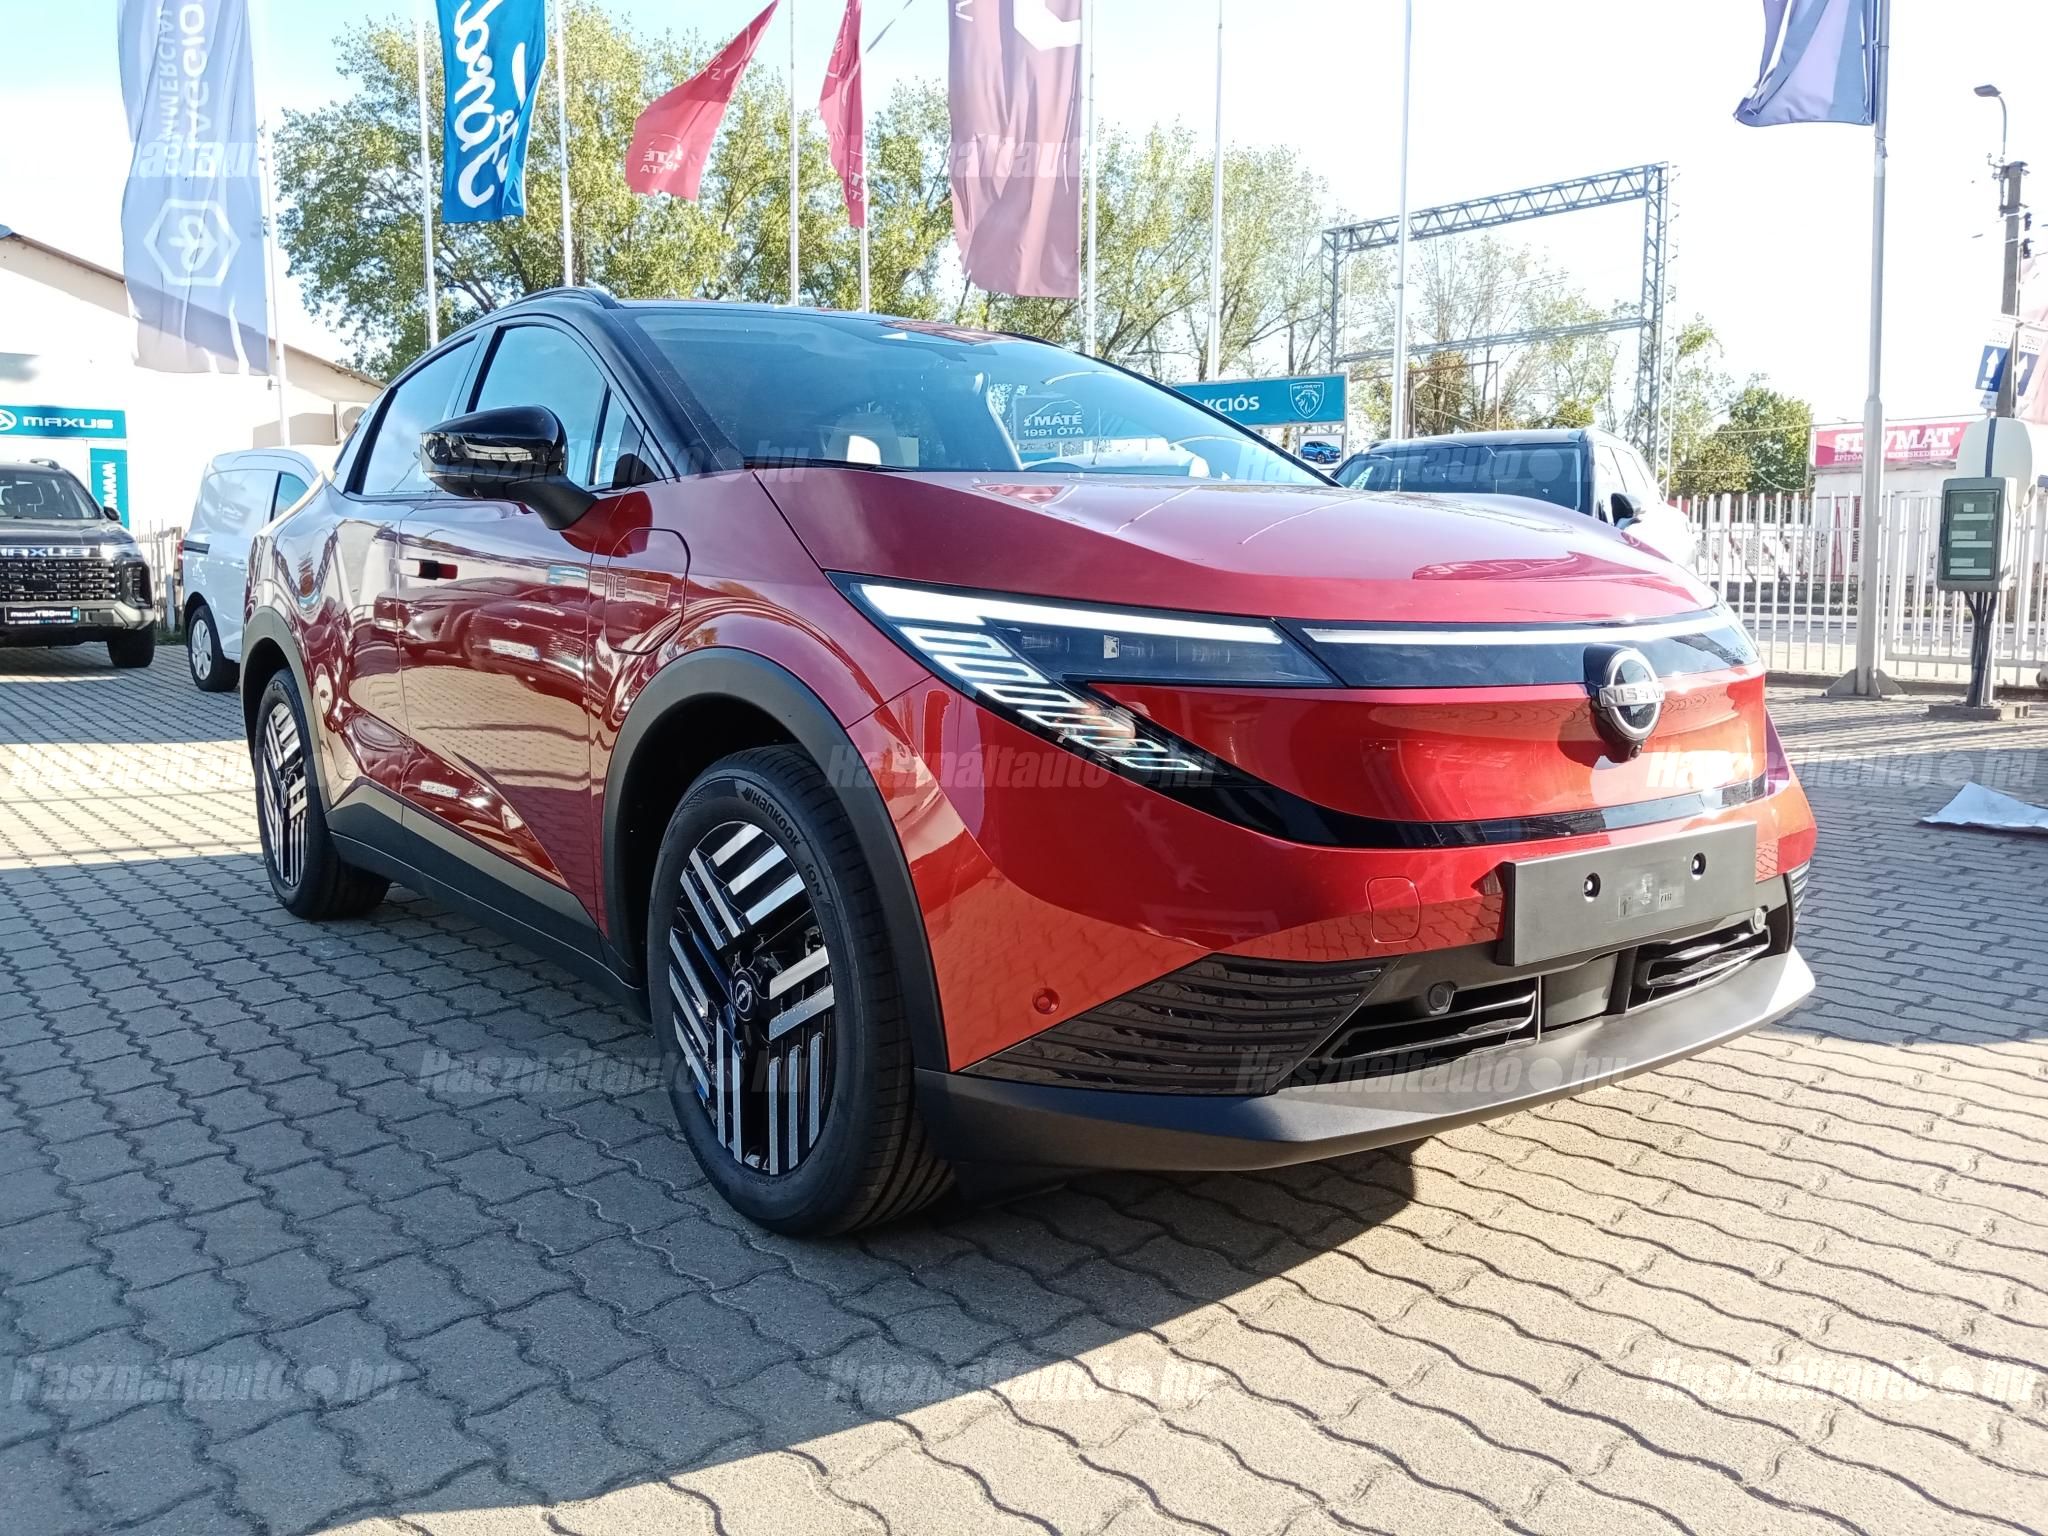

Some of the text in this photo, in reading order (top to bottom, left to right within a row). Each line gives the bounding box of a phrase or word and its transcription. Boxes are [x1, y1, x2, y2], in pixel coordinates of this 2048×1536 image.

[1034, 411, 1083, 426] MÁTÉ
[1023, 426, 1084, 437] 1991 ÓTA
[1834, 427, 1955, 453] STVMAT
